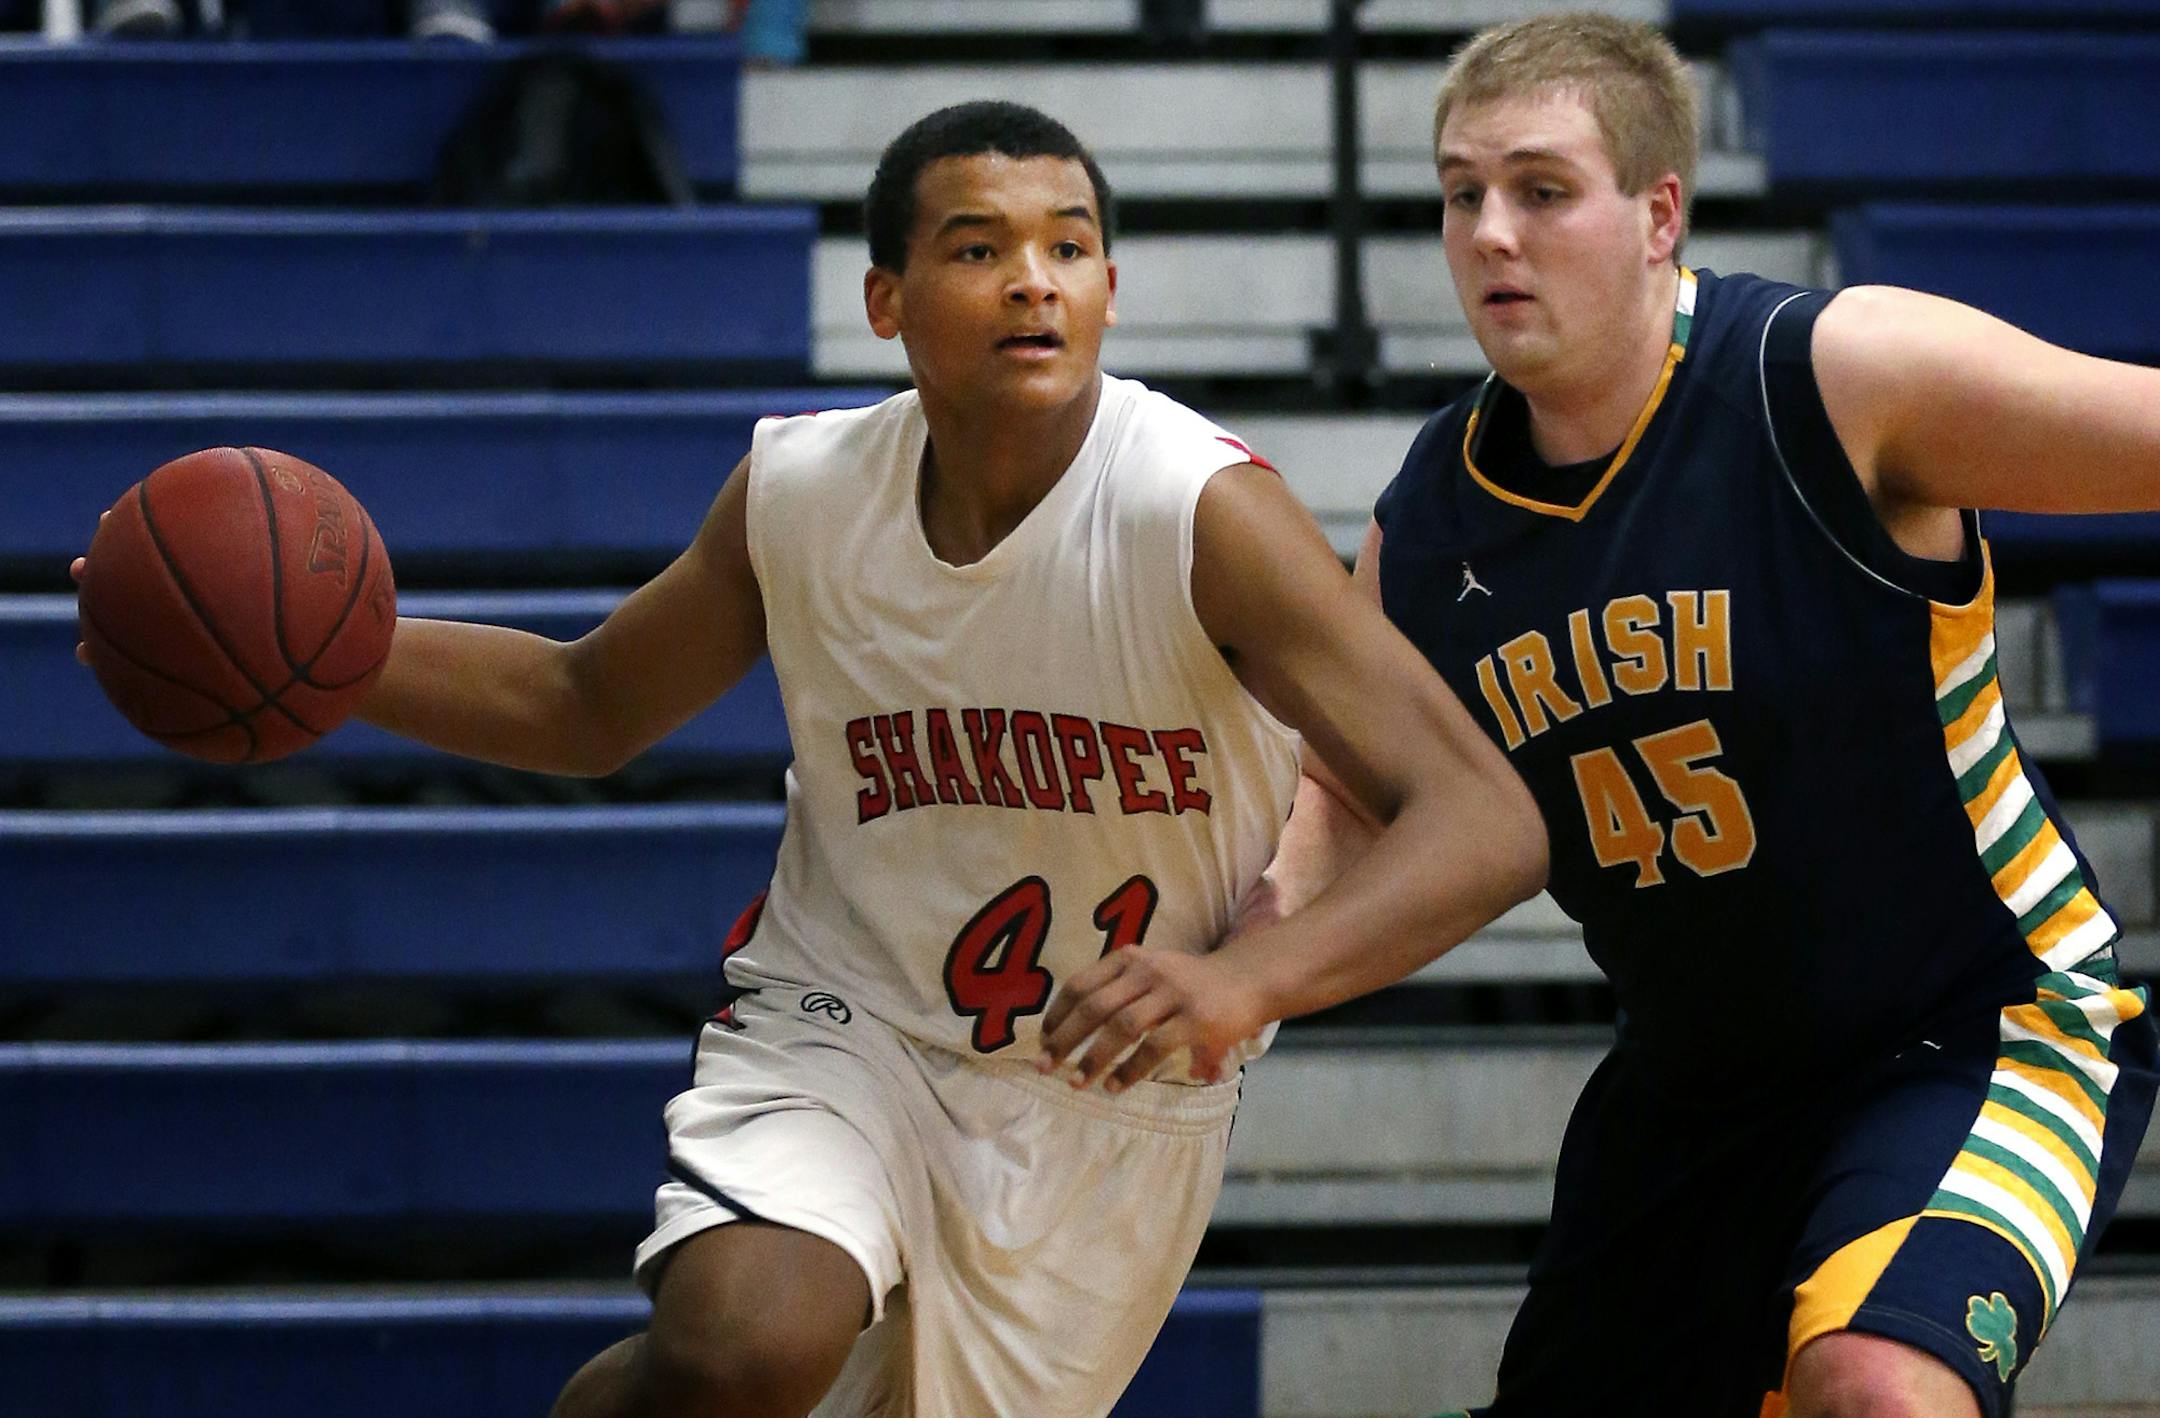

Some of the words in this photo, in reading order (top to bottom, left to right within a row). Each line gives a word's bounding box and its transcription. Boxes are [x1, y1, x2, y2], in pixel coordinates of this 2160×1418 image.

[1475, 589, 1733, 752] IRISH
[846, 708, 1211, 824] SHAKOPEE
[1570, 718, 1757, 888] 45
